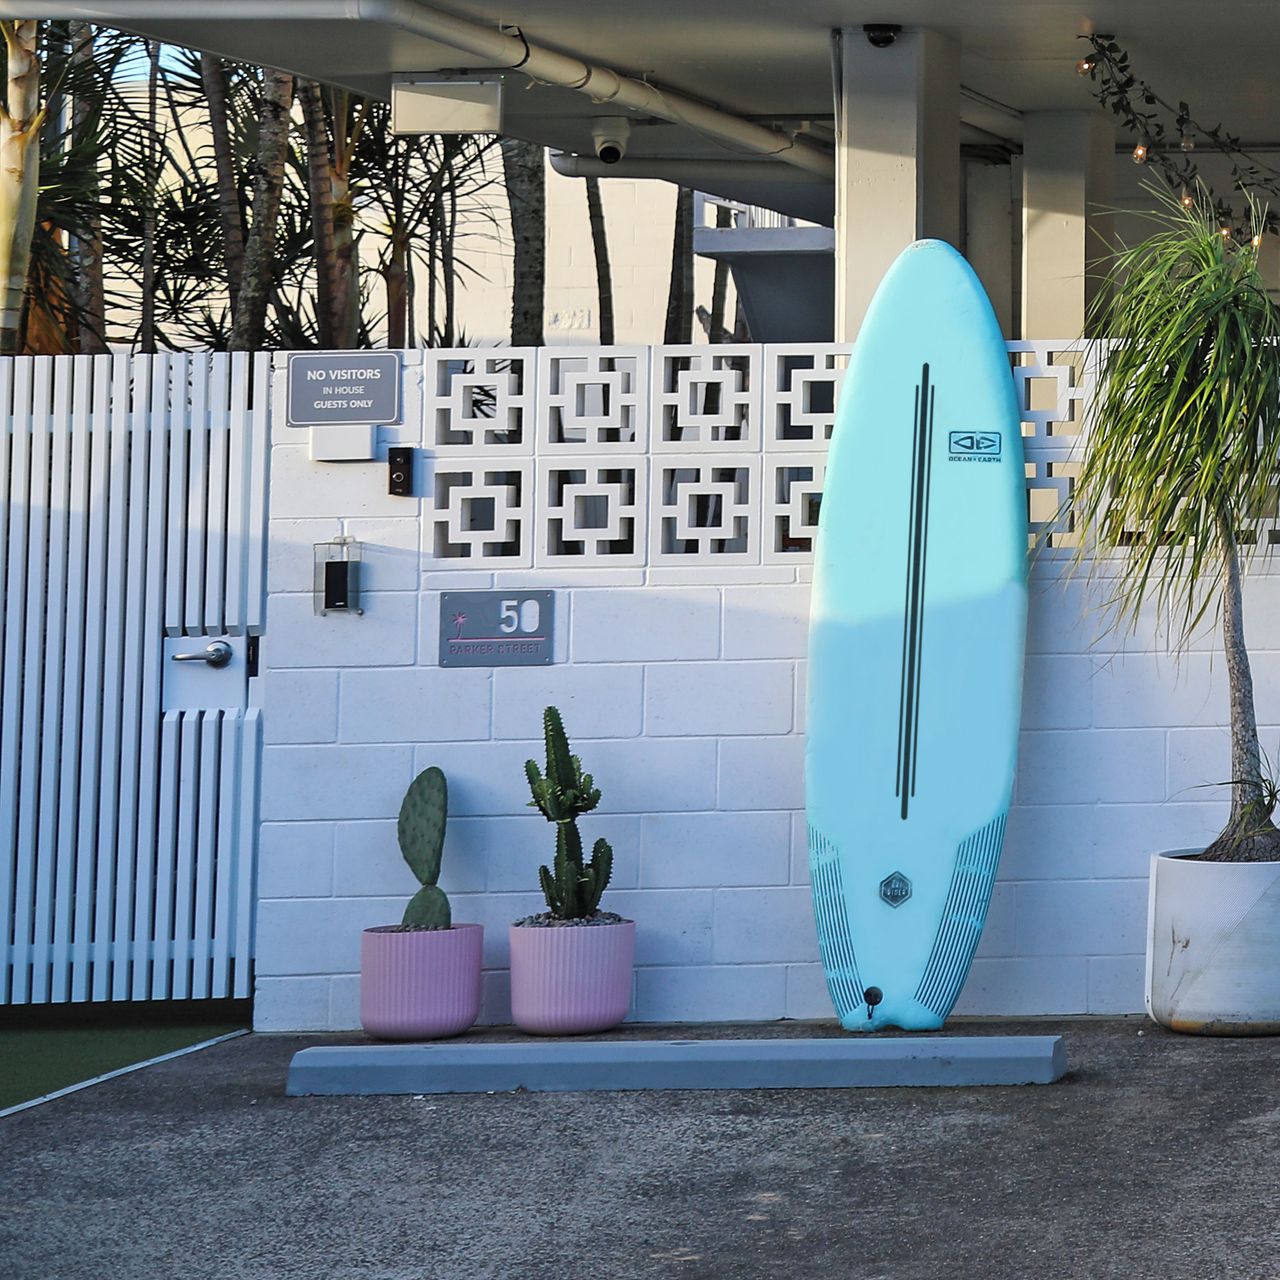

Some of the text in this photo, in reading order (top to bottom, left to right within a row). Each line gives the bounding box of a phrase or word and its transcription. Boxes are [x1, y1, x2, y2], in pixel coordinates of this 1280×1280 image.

[307, 369, 381, 380] NO VISITORS
[323, 386, 365, 394] IN HOUSE
[313, 399, 373, 409] GUESTS ONLY
[500, 599, 540, 633] 50
[449, 643, 541, 655] PARKER STREET
